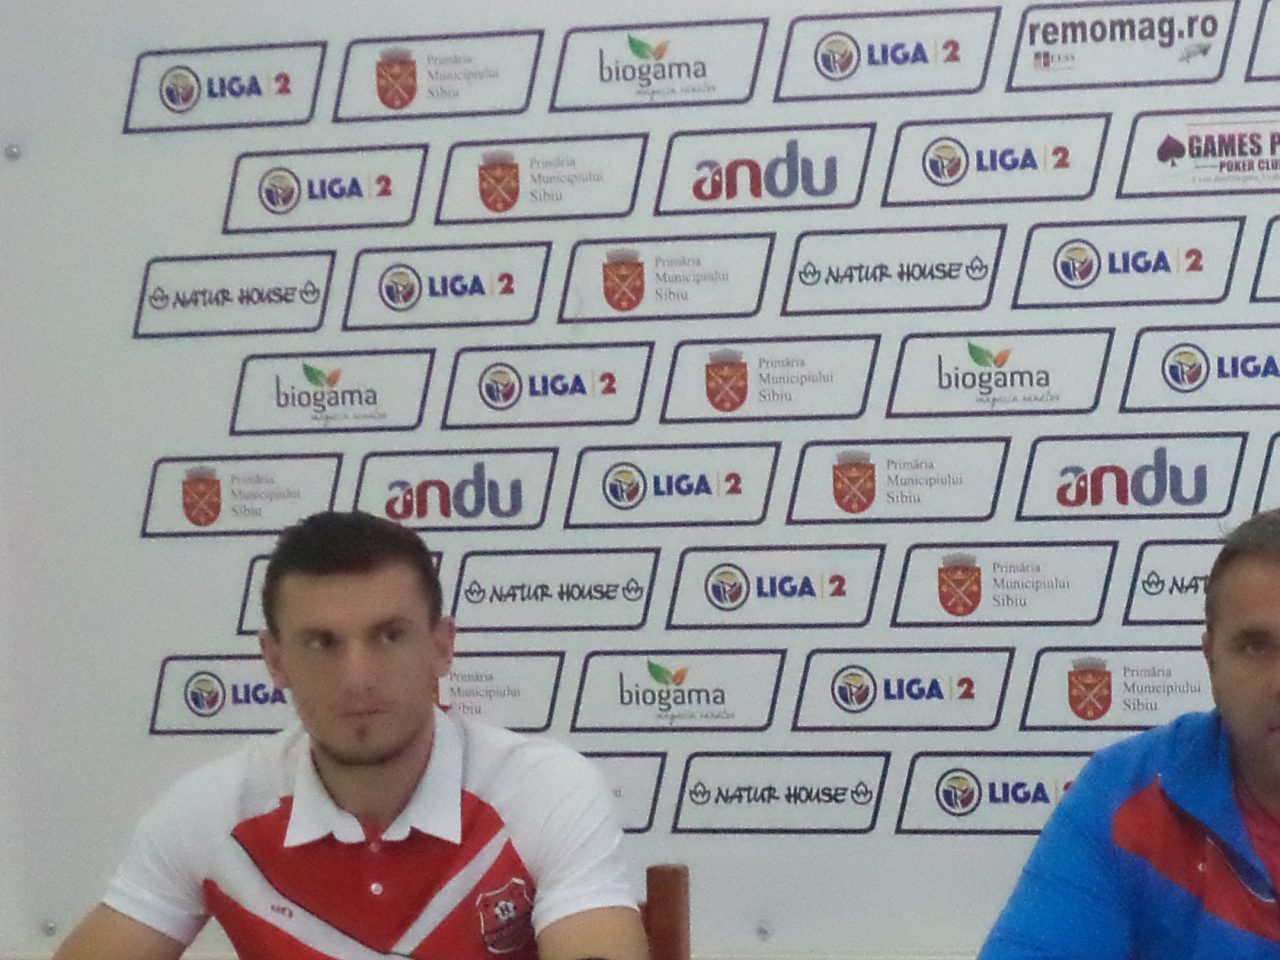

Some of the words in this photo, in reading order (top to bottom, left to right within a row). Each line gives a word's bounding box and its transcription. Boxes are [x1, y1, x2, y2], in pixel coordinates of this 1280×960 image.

[1026, 11, 1218, 51] remomag.ro
[867, 41, 929, 67] LIGA
[942, 39, 960, 63] 2
[599, 45, 709, 90] biogama
[206, 74, 263, 100] LIGA
[274, 72, 291, 96] 2
[427, 85, 460, 100] Sibiu
[1188, 132, 1265, 161] GAMES
[690, 136, 838, 202] andu
[975, 148, 1038, 173] LIGA
[1052, 146, 1070, 169] 2
[1216, 157, 1255, 173] POKER
[307, 177, 364, 201] LIGA
[375, 174, 392, 197] 2
[529, 187, 563, 203] Sibiu
[824, 263, 893, 285] NATUR
[896, 262, 963, 283] HOUSE
[1108, 250, 1172, 275] LIGA
[1185, 248, 1203, 272] 2
[172, 287, 238, 309] NATUR
[237, 286, 297, 306] HOUSE
[427, 273, 486, 298] LIGA
[497, 272, 515, 295] 2
[655, 286, 689, 302] Sibiu
[938, 351, 1052, 398] biogama
[1217, 354, 1280, 379] LIGA
[275, 371, 377, 414] biogama
[528, 373, 587, 398] LIGA
[598, 372, 617, 395] 2
[758, 388, 794, 403] Sibiu
[652, 473, 713, 497] LIGA
[724, 472, 742, 495] 2
[1056, 446, 1208, 509] andu
[383, 461, 523, 523] andu
[885, 490, 923, 506] Sibiu
[231, 504, 262, 518] Sibiu
[489, 583, 553, 604] NATUR
[557, 583, 620, 602] HOUSE
[756, 575, 816, 599] LIGA
[828, 574, 846, 597] 2
[1169, 573, 1207, 595] NAT
[992, 593, 1029, 609] Sibiu
[232, 683, 287, 704] LIGA
[619, 668, 729, 714] biogama
[883, 677, 945, 701] LIGA
[957, 677, 975, 700] 2
[1121, 697, 1158, 713] Sibiu
[714, 784, 781, 805] NATUR
[784, 785, 852, 805] HOUSE
[988, 781, 1050, 805] LIGA
